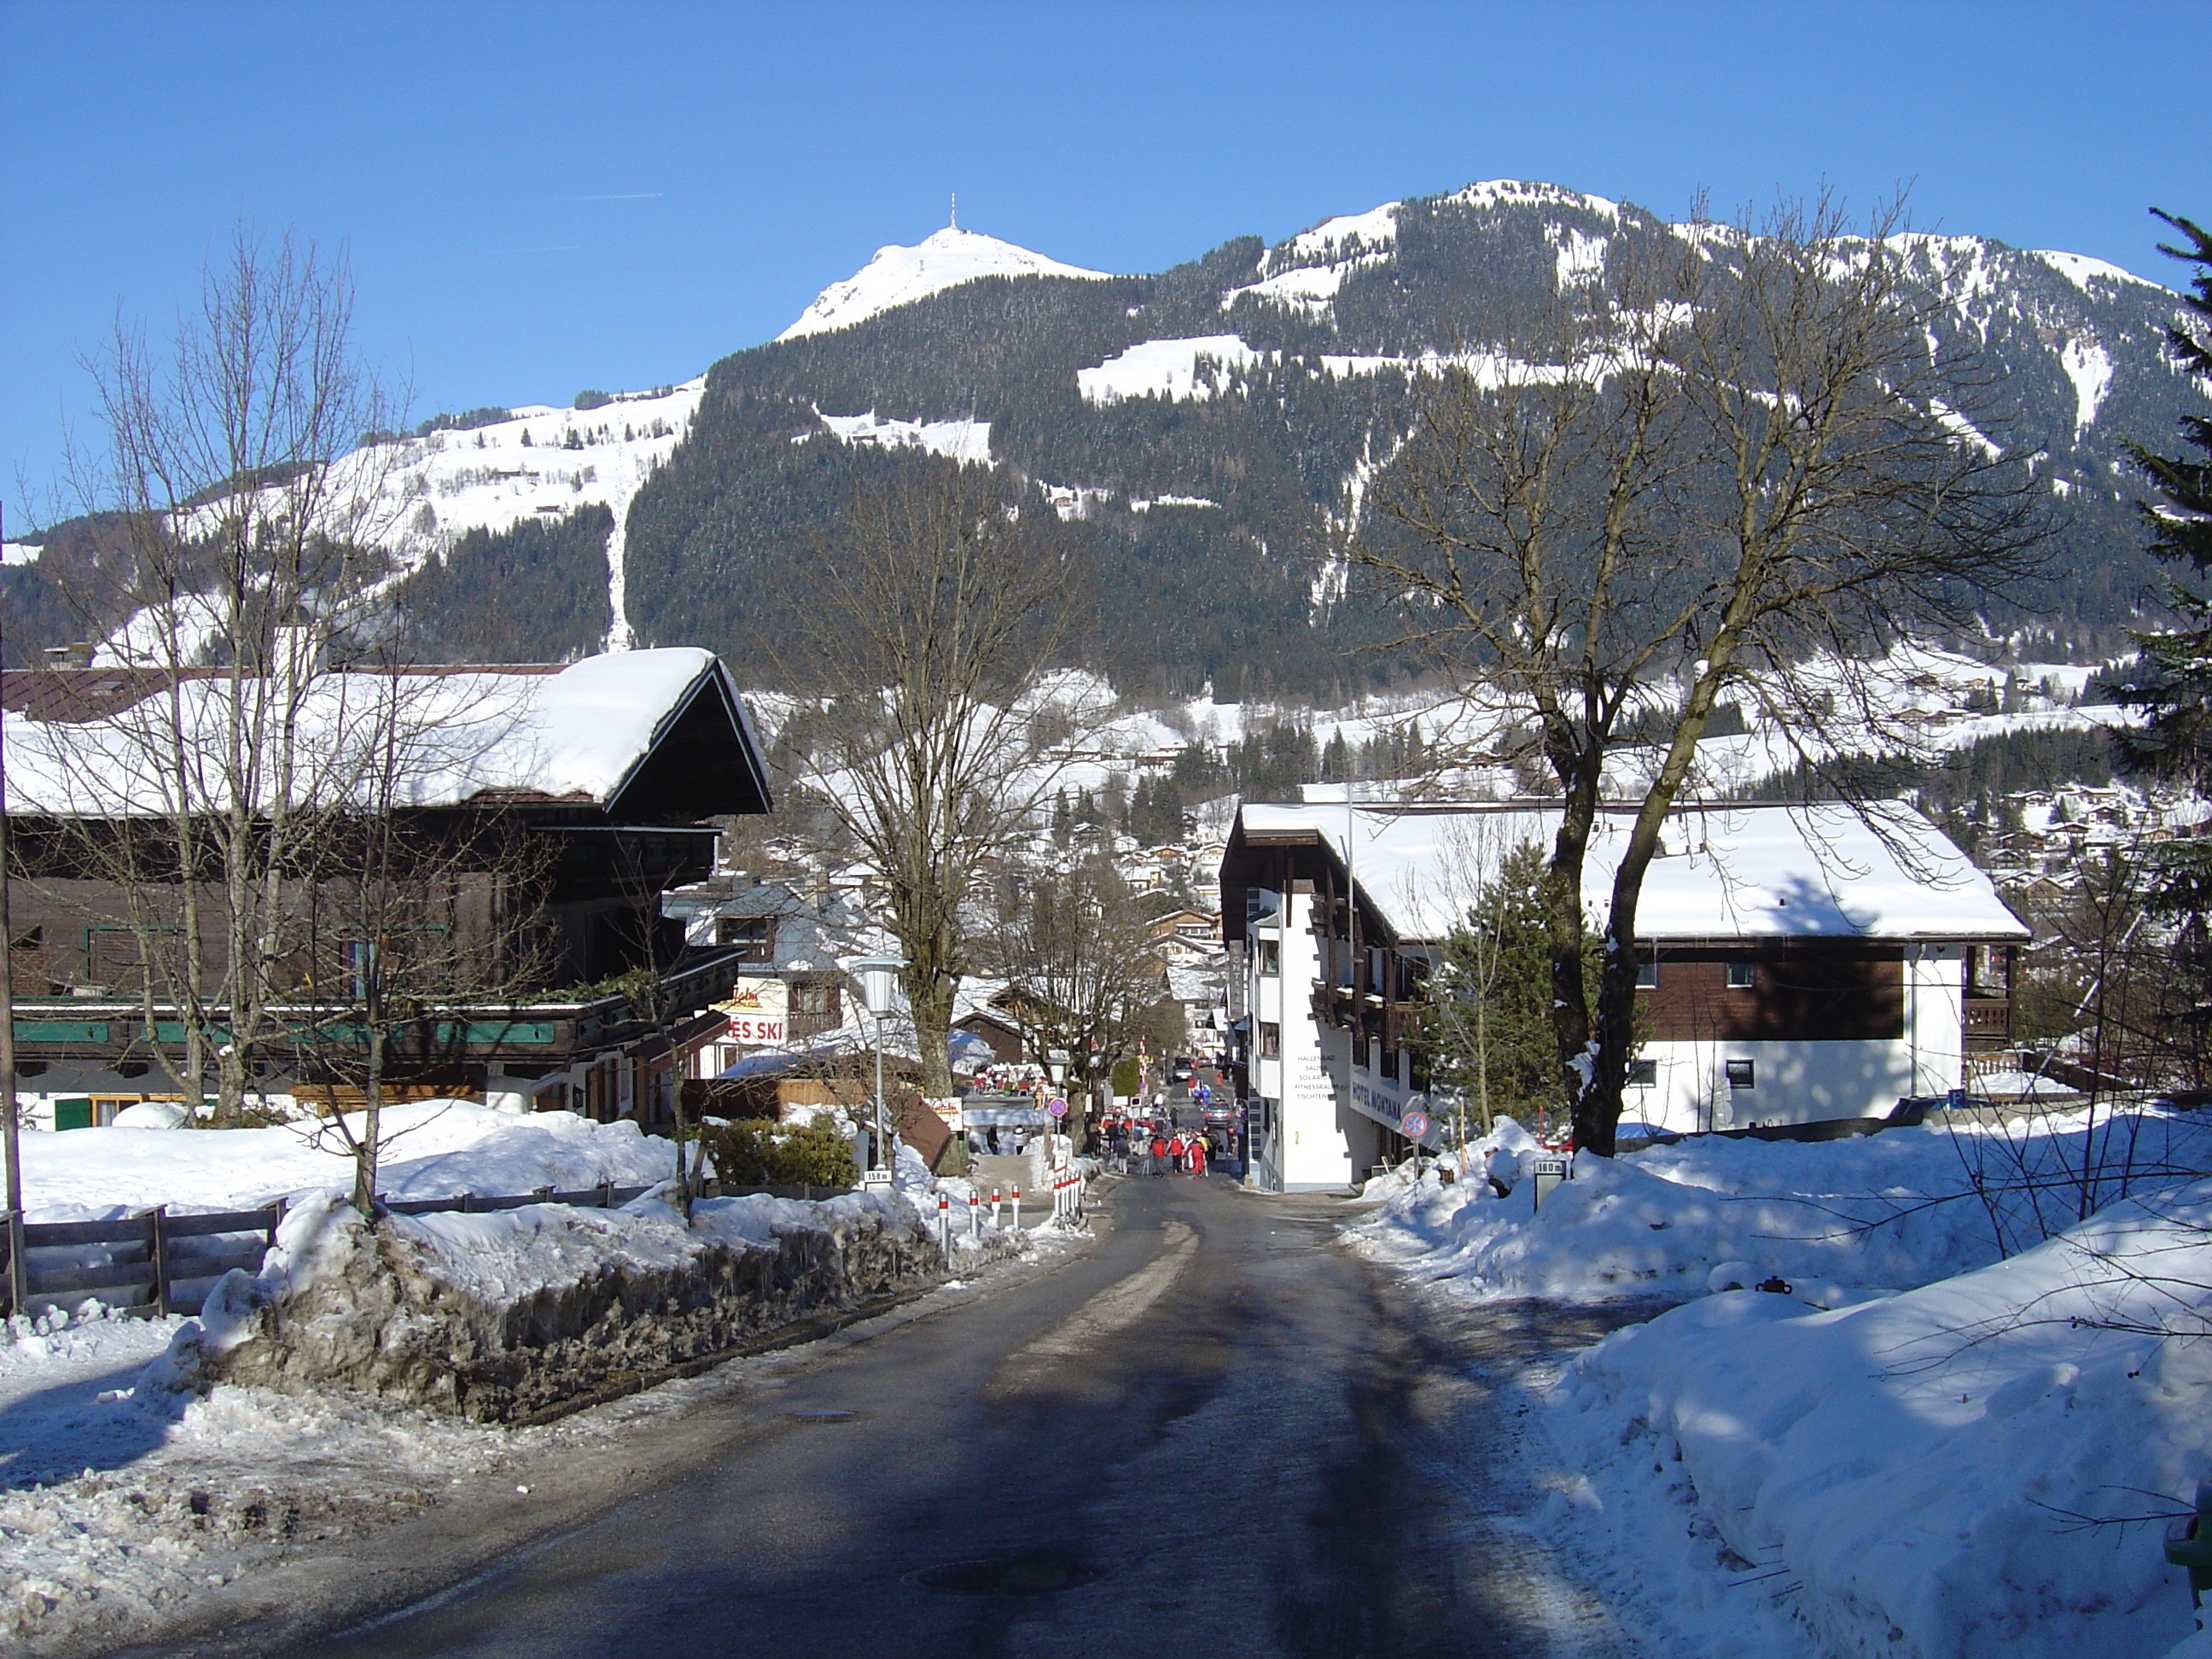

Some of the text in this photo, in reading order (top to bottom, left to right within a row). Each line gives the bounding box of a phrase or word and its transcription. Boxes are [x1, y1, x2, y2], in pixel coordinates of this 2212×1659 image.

[730, 1016, 783, 1039] ÉS SKI
[1353, 1081, 1370, 1107] HOTEL
[1953, 1092, 1962, 1104] P
[1538, 1163, 1553, 1172] 160
